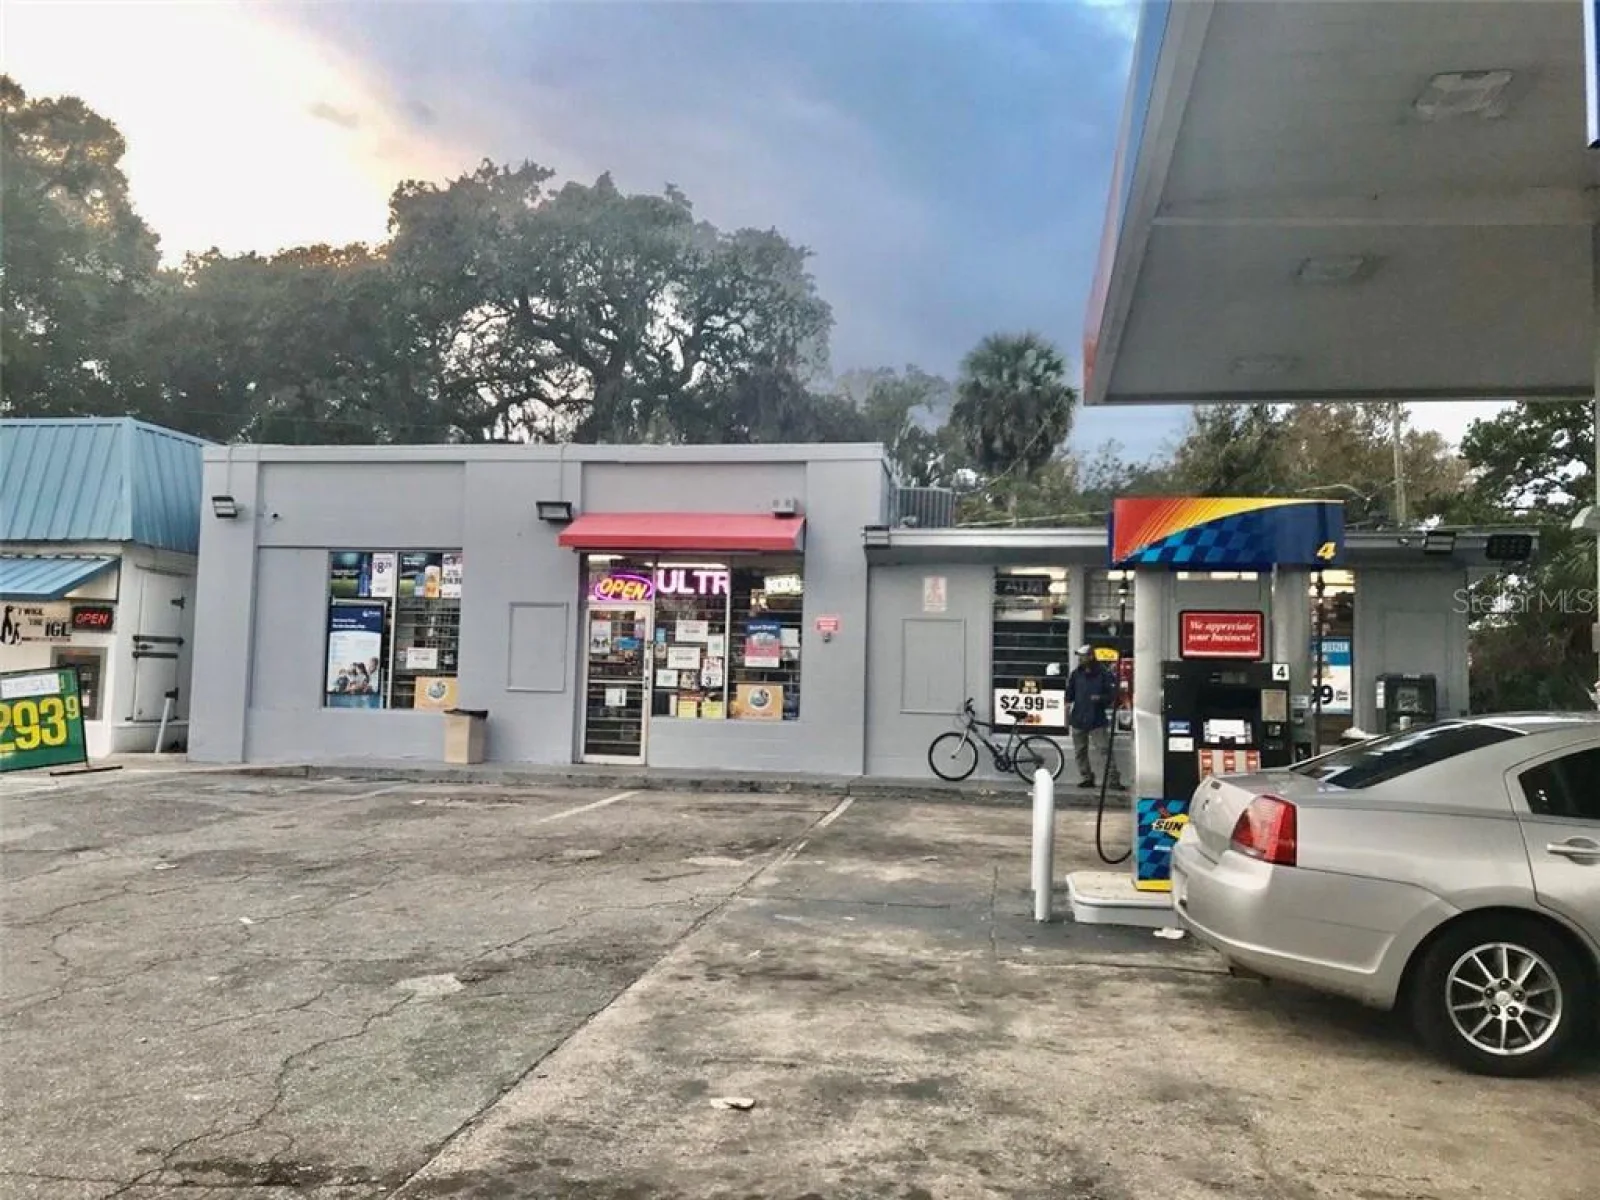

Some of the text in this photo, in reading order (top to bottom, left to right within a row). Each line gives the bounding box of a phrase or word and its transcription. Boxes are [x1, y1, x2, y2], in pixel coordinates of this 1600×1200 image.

[1317, 541, 1336, 560] 4
[599, 575, 648, 599] OPEN
[656, 569, 729, 595] ULTR
[75, 612, 108, 625] OPEN
[1276, 666, 1286, 679] 4
[1000, 694, 1045, 711] $2.99
